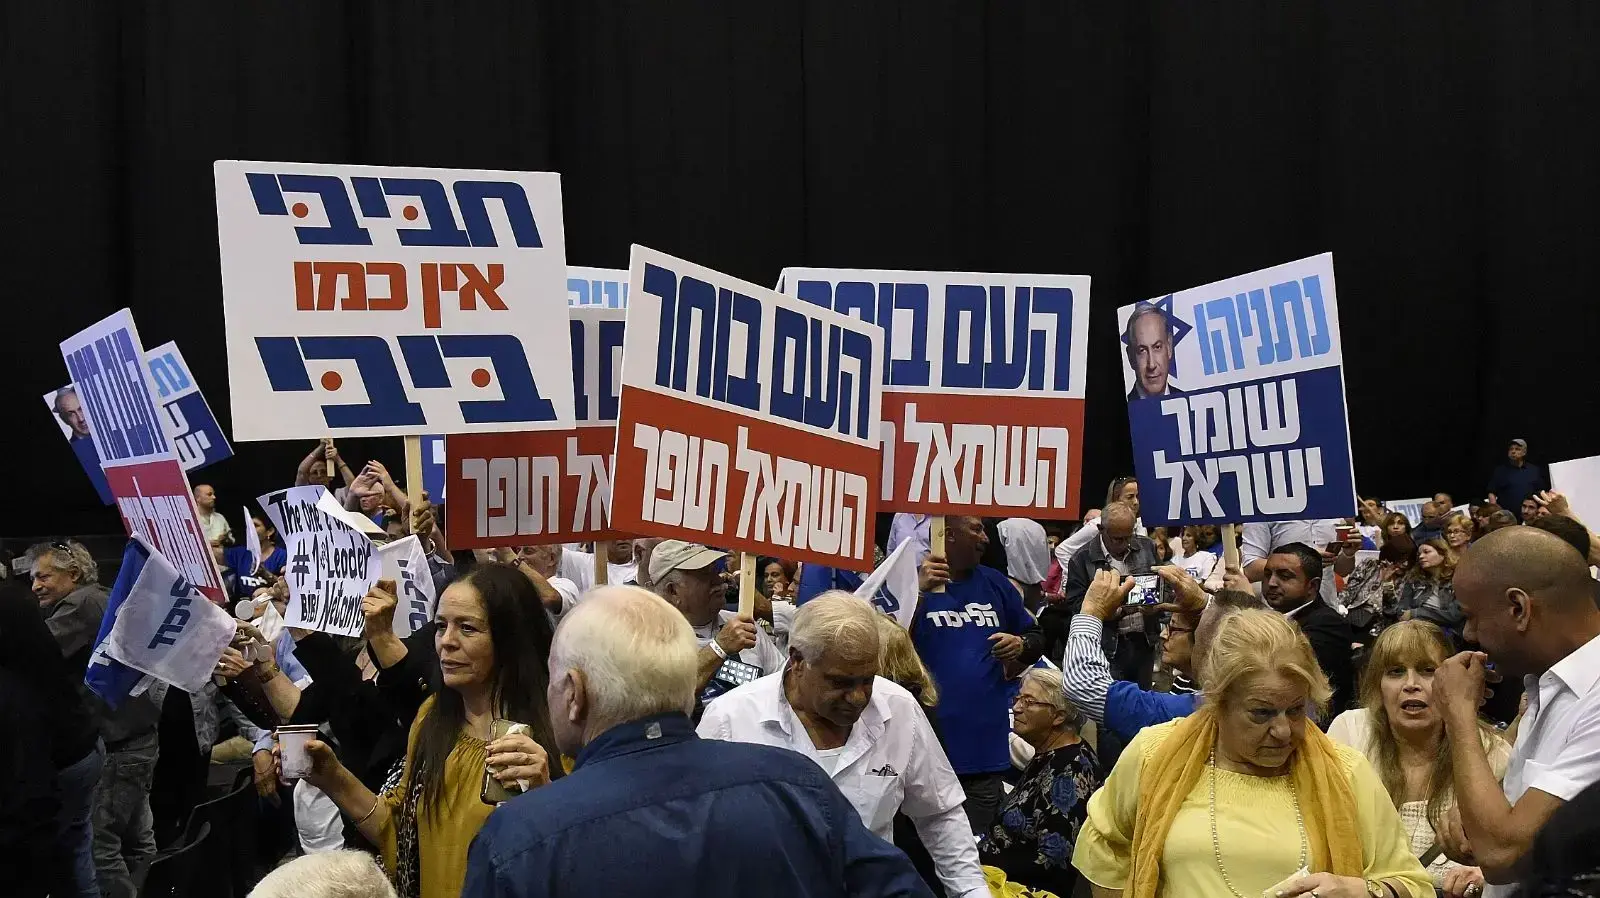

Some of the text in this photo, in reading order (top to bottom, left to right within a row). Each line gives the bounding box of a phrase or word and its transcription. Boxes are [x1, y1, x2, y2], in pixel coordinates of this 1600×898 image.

[246, 173, 543, 248] חביבי
[294, 261, 408, 311] כמו
[421, 262, 509, 329] אין
[1192, 274, 1332, 376] נתניהו
[643, 262, 763, 411] בוחר
[770, 305, 873, 440] העם
[941, 283, 1074, 392] העם
[94, 327, 169, 458] העם
[255, 334, 558, 428] ביבי
[1160, 378, 1301, 456] שומר
[462, 455, 559, 538] תופר
[633, 422, 730, 536] תופר
[736, 426, 869, 560] השמאל
[903, 402, 1070, 510] השמאל
[1153, 446, 1324, 520] ישראל
[267, 490, 303, 537] The
[324, 534, 372, 581] Leader
[926, 602, 1000, 628] הליכוד
